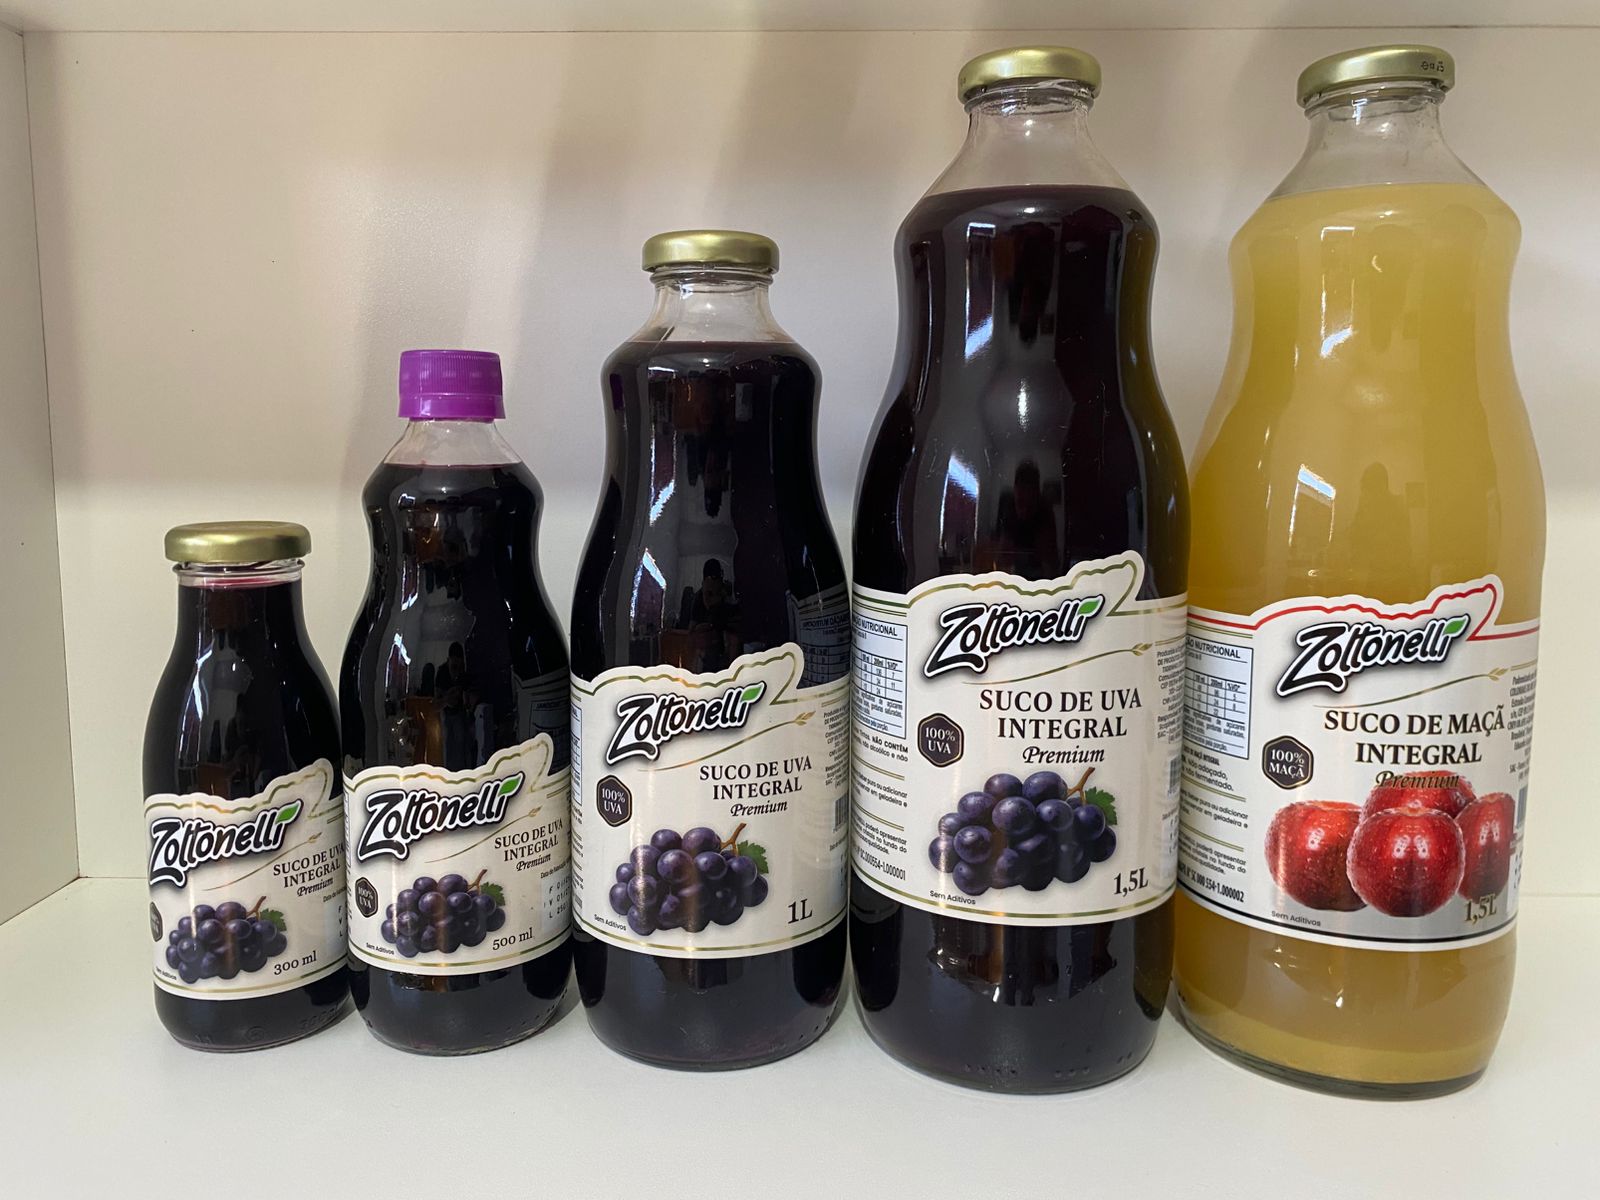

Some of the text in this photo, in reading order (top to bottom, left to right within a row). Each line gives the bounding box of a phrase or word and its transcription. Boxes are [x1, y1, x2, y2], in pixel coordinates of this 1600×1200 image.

[861, 620, 898, 636] NUTRICIONAL
[1194, 640, 1241, 659] NUTRICIONAL
[979, 689, 1054, 713] SUCO
[1059, 690, 1097, 713] DE
[1101, 687, 1143, 712] UVA
[997, 716, 1128, 740] INTEGRAL
[1324, 709, 1400, 735] SUCO
[1405, 714, 1443, 735] DE
[1447, 704, 1505, 740] MAÇÃ
[925, 726, 956, 742] 100%
[927, 739, 952, 756] UVA
[1022, 746, 1105, 764] Premium
[1269, 748, 1305, 765] 100%
[1355, 741, 1482, 765] INTEGRAL
[699, 755, 812, 781] SUCO DE UVA
[1268, 761, 1305, 780] MAÇÃ
[712, 776, 803, 800] INTEGRAL
[1375, 770, 1461, 790] Premium
[601, 787, 626, 803] 100%
[603, 800, 623, 815] UVA
[730, 799, 788, 817] Premium
[494, 819, 563, 849] SUCO DE UVA
[503, 834, 559, 861] INTEGRAL
[273, 857, 310, 876] SUCO
[313, 851, 328, 866] DE
[515, 854, 551, 872] Premium
[284, 859, 341, 888] INTEGRAL
[1113, 867, 1149, 897] 1,5L
[296, 878, 334, 897] Premium
[929, 889, 976, 906] Sem Aditivos
[787, 898, 813, 924] 1L
[1271, 909, 1322, 926] Sem Aditivos
[1464, 894, 1499, 923] 1,5L
[594, 913, 627, 932] Sem Aditivos
[492, 928, 533, 951] 500 ml
[274, 950, 317, 976] 300 ml
